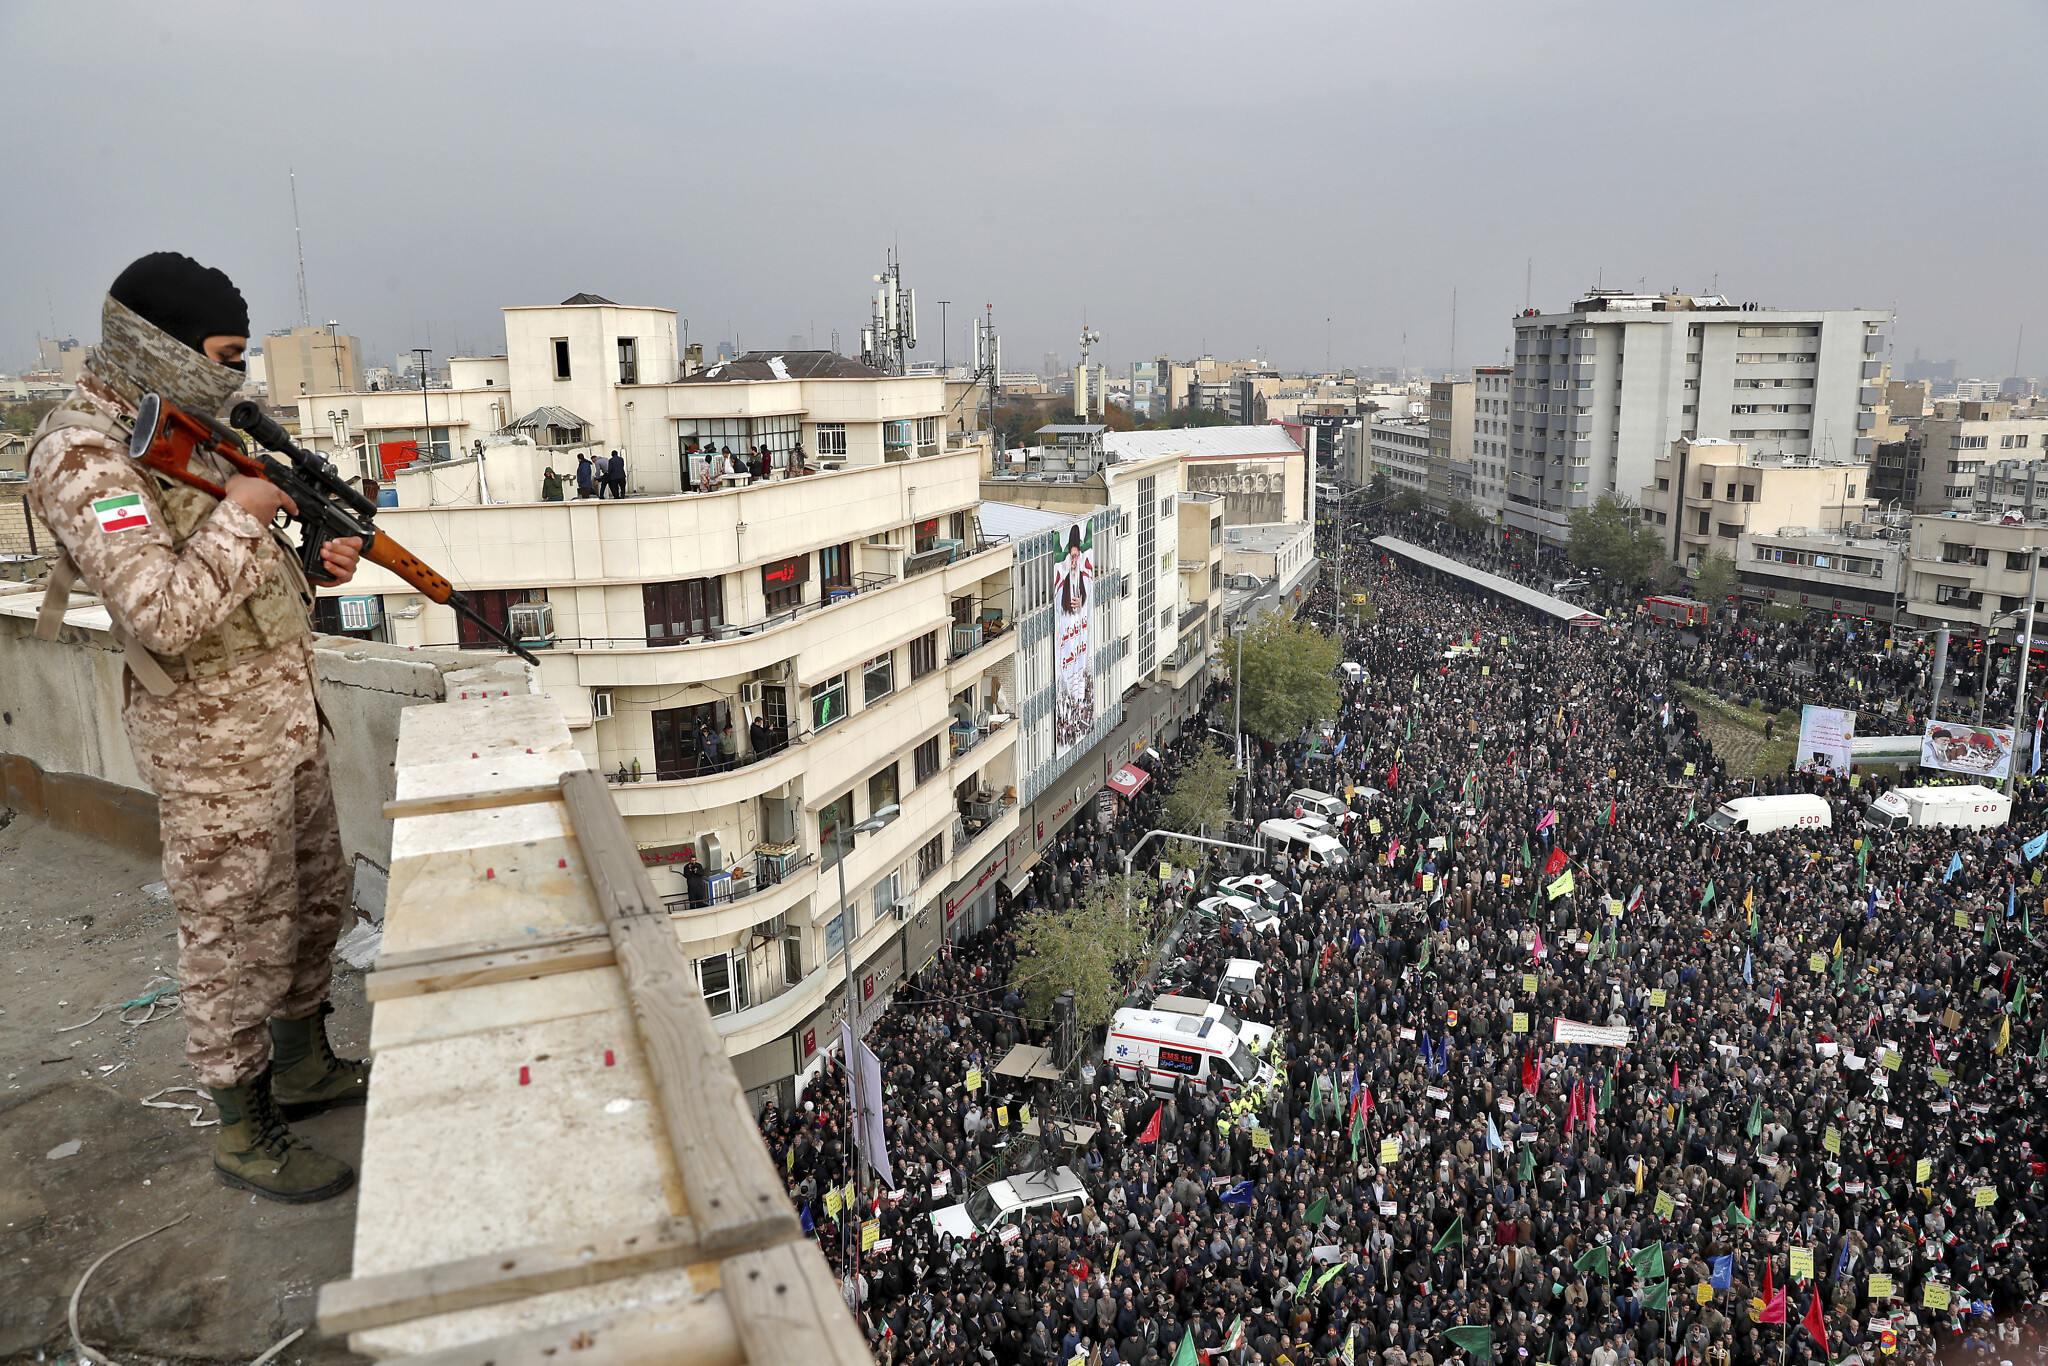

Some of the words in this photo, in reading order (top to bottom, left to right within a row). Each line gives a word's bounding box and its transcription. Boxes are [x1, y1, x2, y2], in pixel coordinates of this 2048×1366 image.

[1883, 794, 1898, 804] EOD
[1974, 804, 1998, 813] EOD
[1799, 815, 1821, 825] EOD
[1161, 1051, 1180, 1061] EMS
[1180, 1055, 1193, 1063] 115
